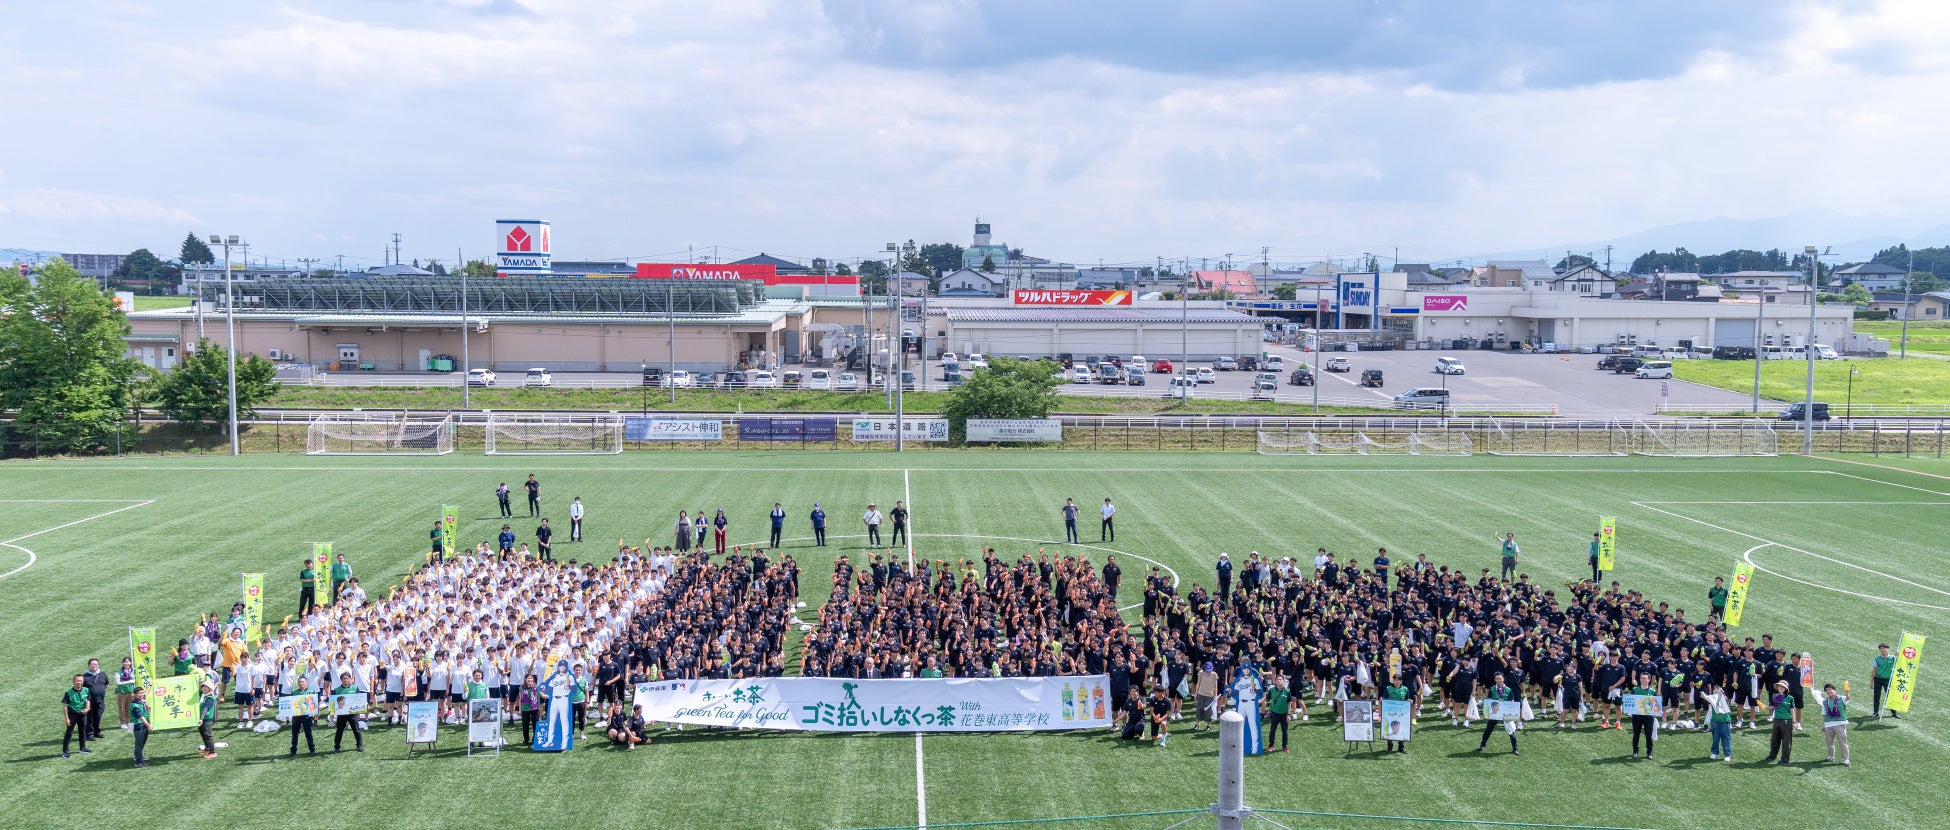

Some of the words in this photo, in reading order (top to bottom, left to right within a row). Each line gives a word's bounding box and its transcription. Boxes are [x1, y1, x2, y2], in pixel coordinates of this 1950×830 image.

[502, 257, 537, 266] YAMADA
[686, 268, 741, 279] YAMADA
[1018, 292, 1092, 303] ツルハドラッグ
[1350, 291, 1370, 306] SUNDAY
[664, 422, 719, 432] アシスト伸和
[162, 695, 184, 718] 岩手
[802, 699, 956, 726] ゴミ拾いしなくっ茶
[959, 701, 982, 711] With
[714, 703, 736, 719] Tea
[736, 711, 753, 720] for
[755, 707, 790, 723] Good
[960, 712, 1050, 727] 花巻東高等学校
